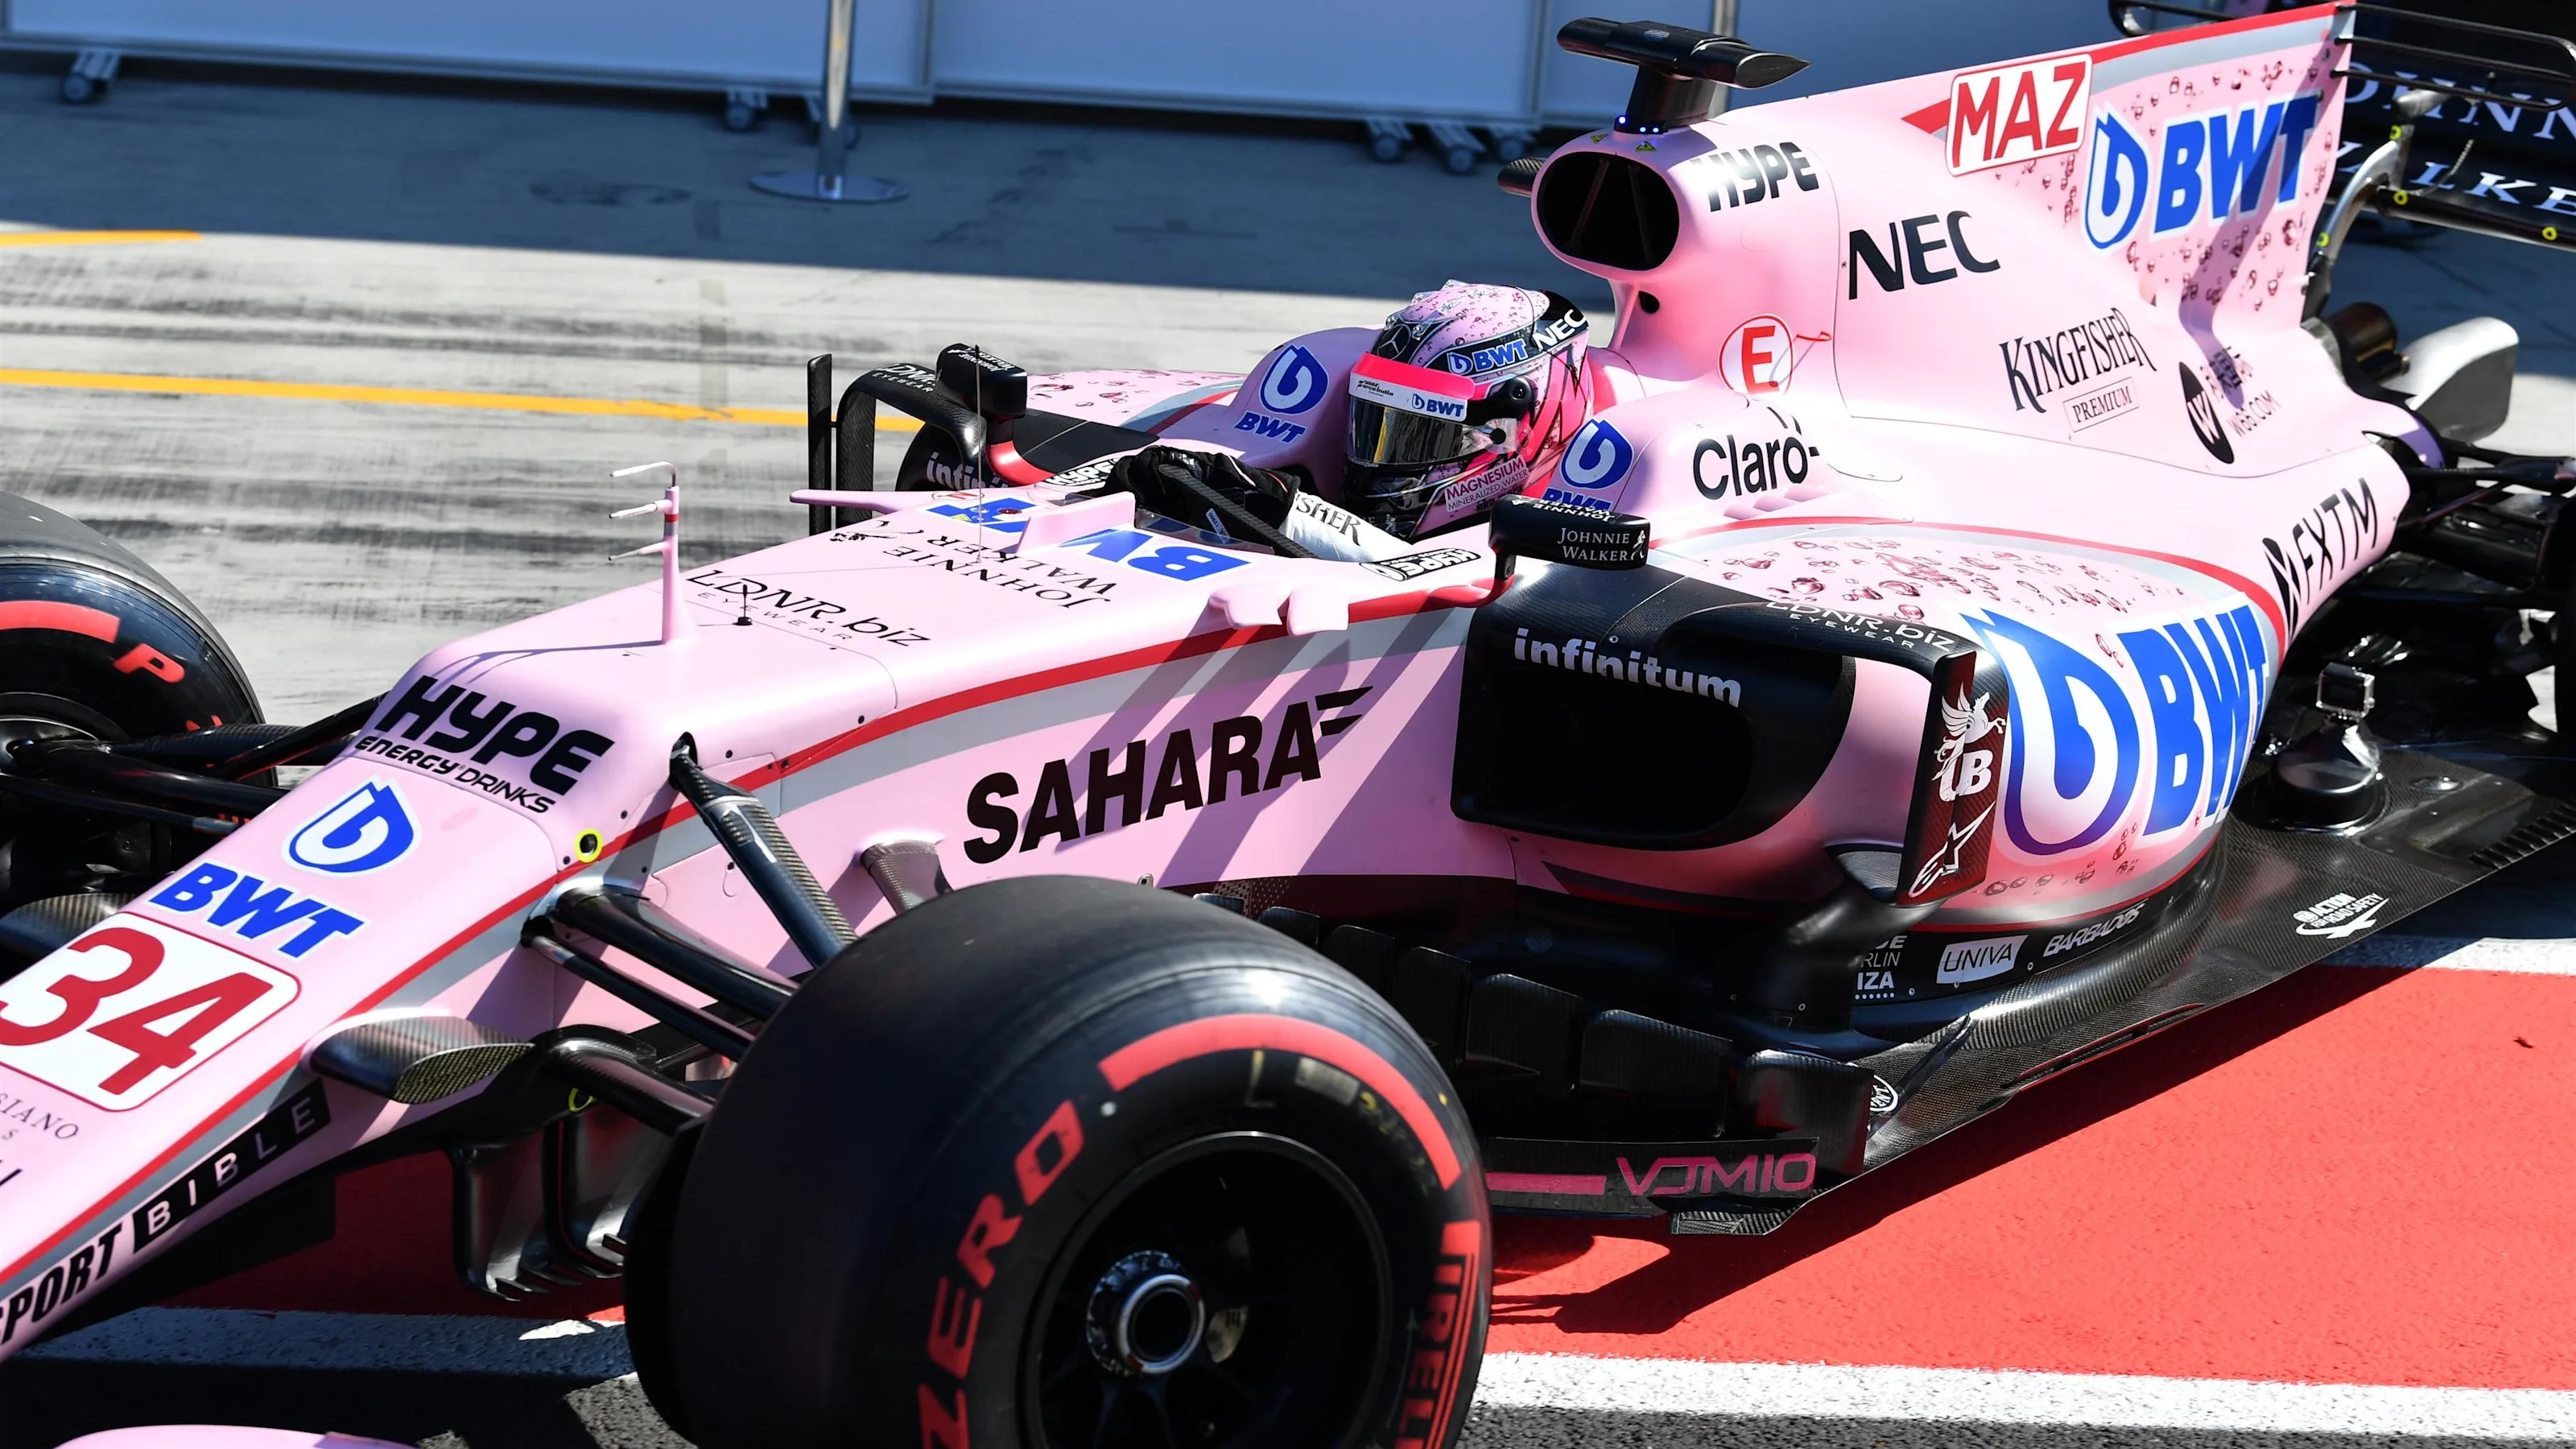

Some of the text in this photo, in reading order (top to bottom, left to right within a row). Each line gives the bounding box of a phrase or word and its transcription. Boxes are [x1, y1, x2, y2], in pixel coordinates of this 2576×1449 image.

[1951, 61, 2087, 167] MAZ
[1693, 142, 1819, 213] HYPE
[2153, 94, 2320, 234] BWT
[1848, 211, 1999, 299] NEC
[1472, 338, 1530, 372] BWT
[1532, 309, 1587, 352] NEC
[1742, 325, 1778, 394] E
[2000, 307, 2157, 414] KINGFISHER
[1234, 411, 1306, 444] BWT
[1426, 399, 1464, 417] BWT
[2072, 386, 2132, 423] PREMIUM
[1447, 457, 1525, 500] MAGNESIUM
[1448, 483, 1501, 510] MINERALIZED
[1501, 469, 1529, 489] WATER
[1693, 434, 1808, 500] Claro
[1533, 503, 1615, 522] JOHNNIE
[1557, 527, 1630, 545] JOHNNIE
[882, 546, 1112, 608] JOHNNIE
[927, 535, 1118, 596] WALKER
[1389, 548, 1478, 576] HYPE
[1563, 545, 1628, 562] WALKER
[696, 591, 854, 641] EYEWEAR
[1789, 613, 1915, 649] EYEWEAR
[1513, 627, 1741, 708] infinitum
[374, 675, 615, 796] HYPE
[2116, 604, 2267, 836] BWT
[354, 735, 557, 814] ENERGY DRINKS
[963, 701, 1322, 865] SAHARA
[150, 862, 363, 958] BWT
[2309, 892, 2357, 917] ACTION
[2322, 907, 2355, 923] ROAD
[2345, 893, 2384, 913] SAFETY
[1856, 972, 1894, 990] IZA
[1943, 943, 2014, 973] UNIVA
[0, 927, 273, 1095] 34
[147, 1096, 317, 1236] BIBLE
[919, 1099, 1086, 1449] ZERO
